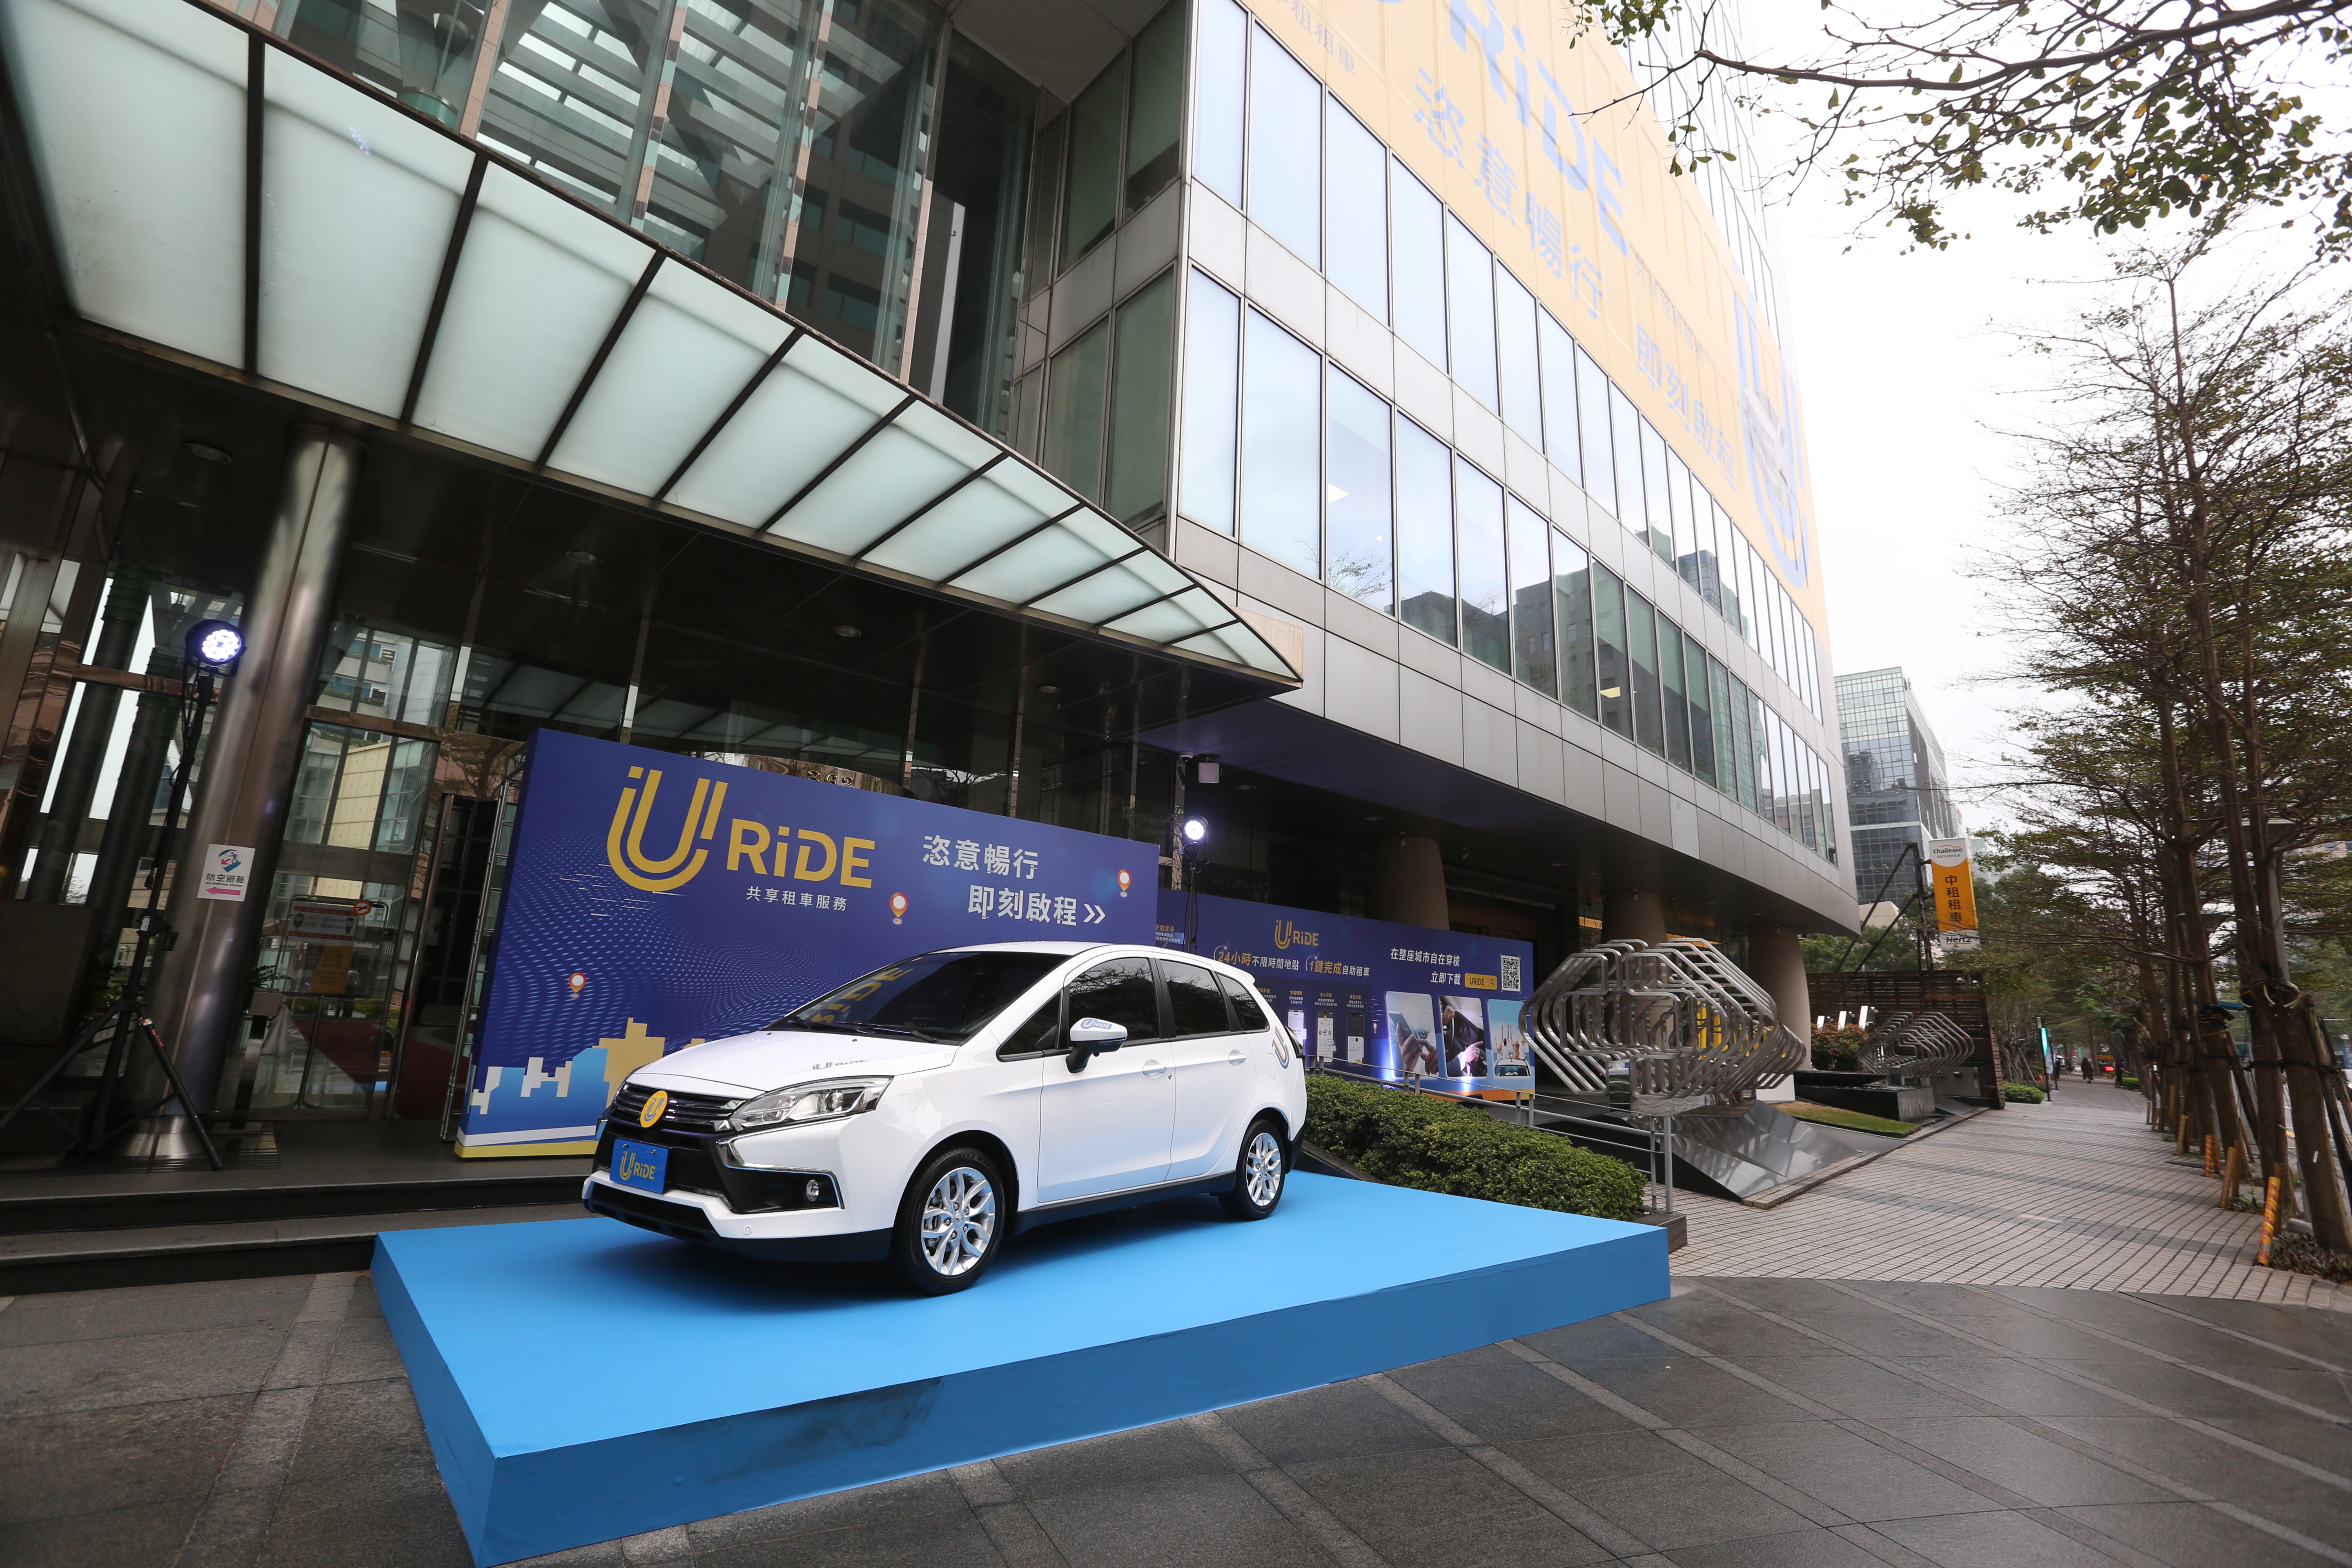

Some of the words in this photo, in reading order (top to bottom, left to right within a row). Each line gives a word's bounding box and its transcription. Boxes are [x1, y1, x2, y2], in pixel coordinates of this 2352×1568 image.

[1276, 0, 1356, 76] 租租車
[1412, 67, 1604, 320] 恣意暢行
[1637, 322, 1737, 492] 即刻啟程
[807, 769, 855, 788] 362
[206, 873, 245, 884] 防空避難
[922, 835, 1038, 880] 恣意暢行
[746, 886, 847, 911] 共享租車服務
[968, 884, 1077, 926] 即刻啟程
[1945, 875, 1962, 922] 中租租車
[1390, 947, 1460, 967] 在整座城市自在穿梭
[1430, 971, 1461, 985] 立即下載
